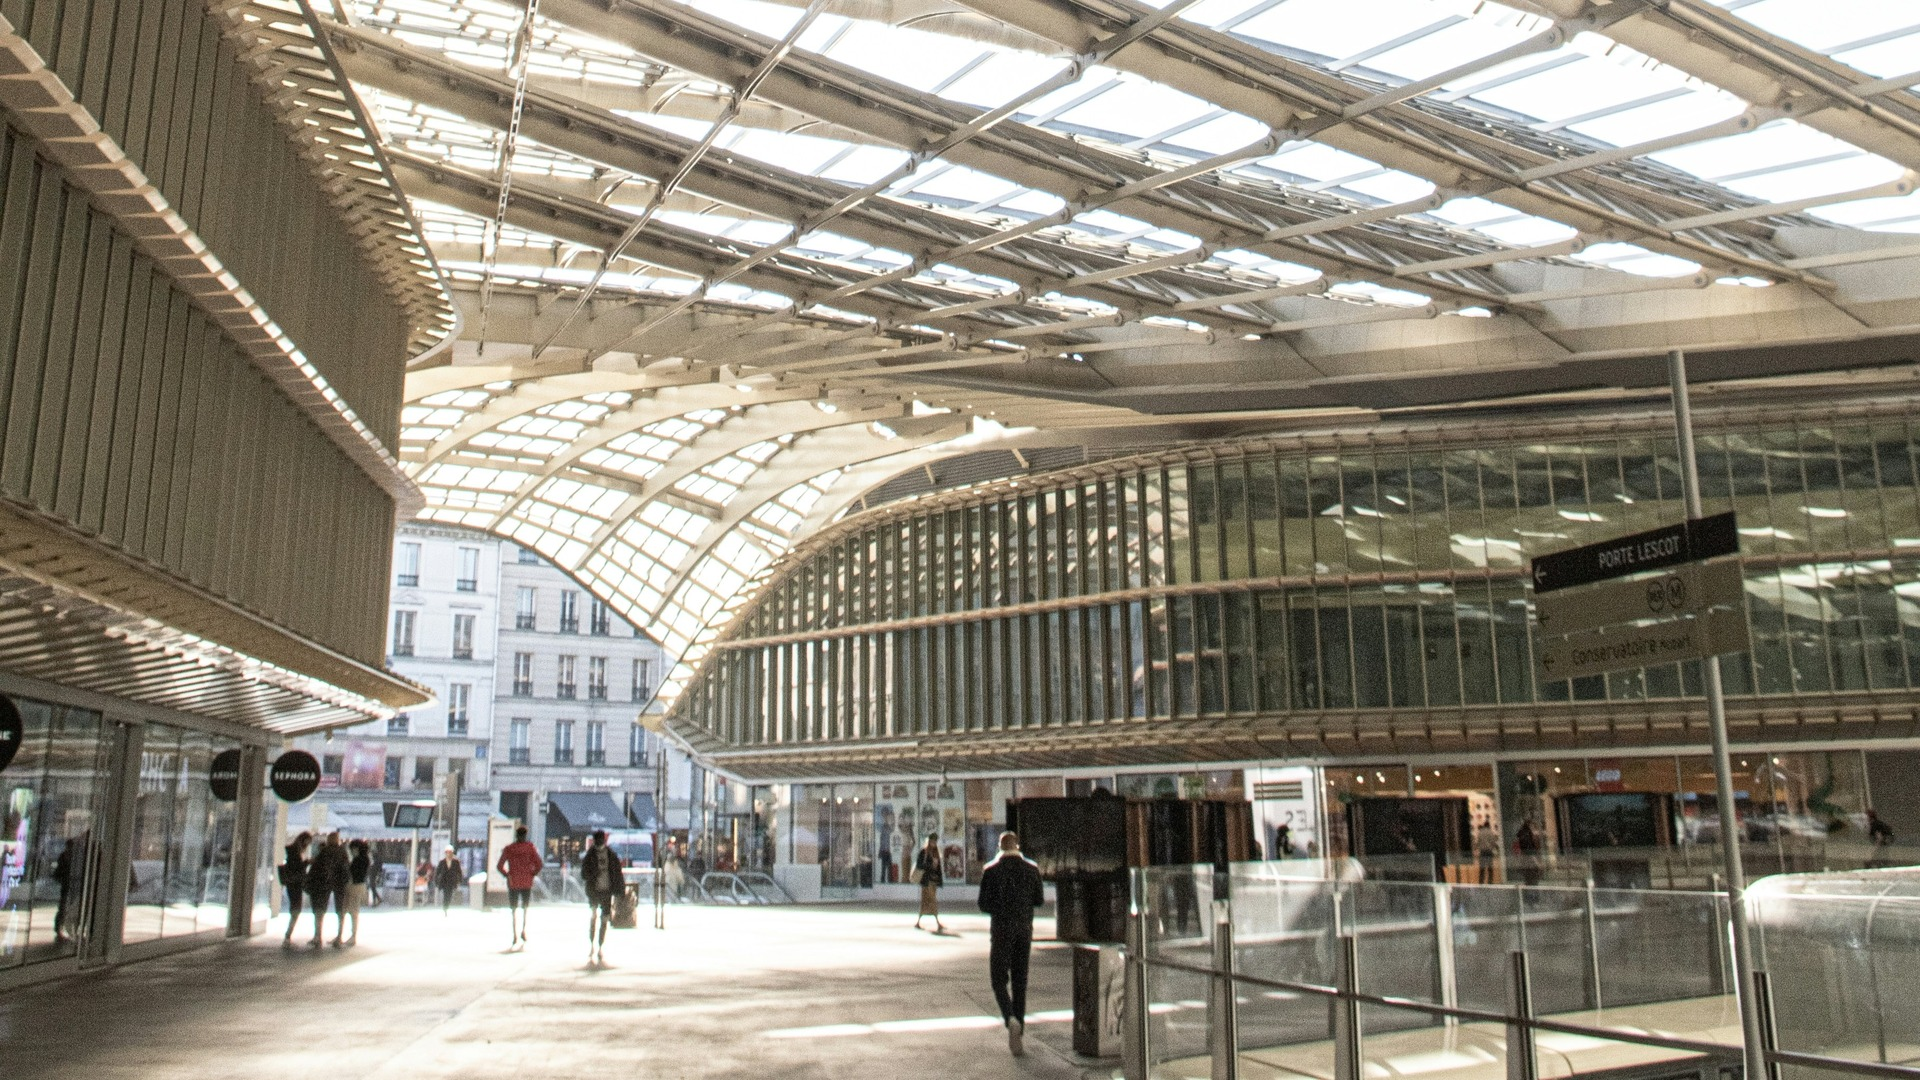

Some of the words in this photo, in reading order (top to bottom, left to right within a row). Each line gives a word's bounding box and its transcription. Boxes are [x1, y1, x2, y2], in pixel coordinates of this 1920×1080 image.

[1599, 545, 1634, 569] PORTE
[1638, 535, 1680, 561] LESCOT
[1572, 638, 1658, 666] Conservatoire
[274, 771, 316, 781] SEPHORA
